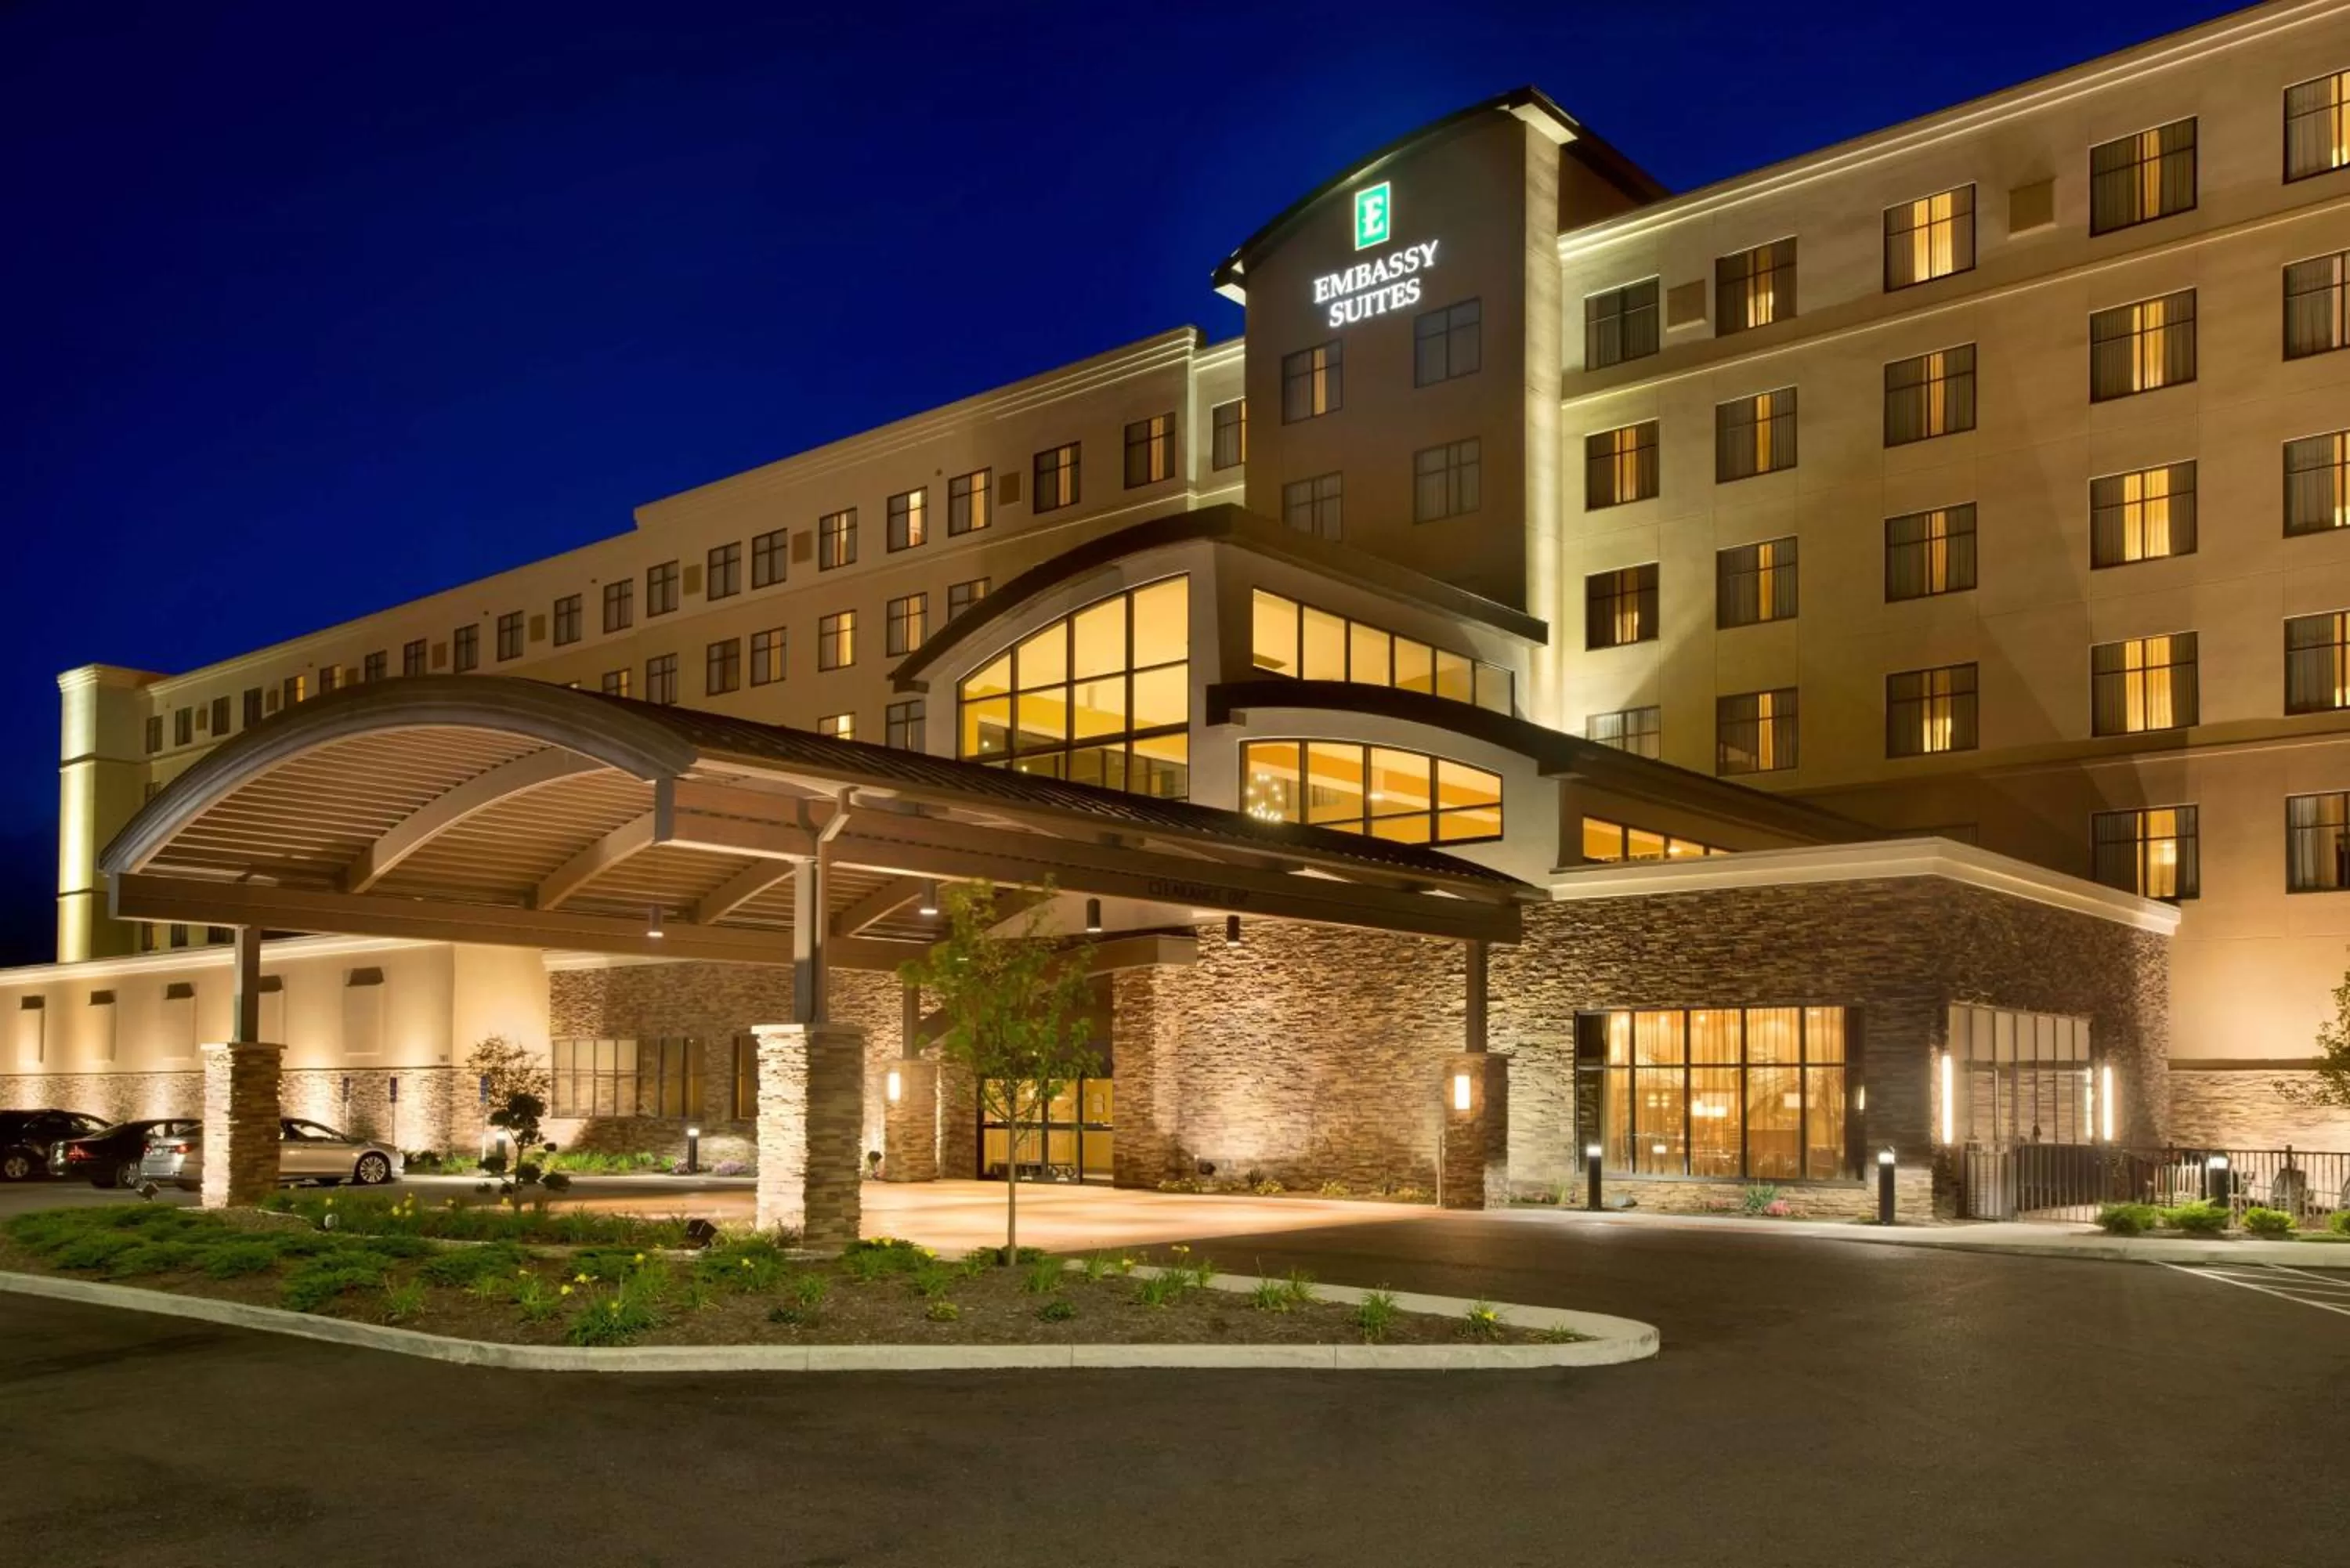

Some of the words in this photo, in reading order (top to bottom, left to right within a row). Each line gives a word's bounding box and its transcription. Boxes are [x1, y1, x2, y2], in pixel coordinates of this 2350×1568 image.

[1361, 196, 1384, 237] E
[1313, 239, 1438, 304] EMBASSY
[1329, 278, 1421, 327] SUITES
